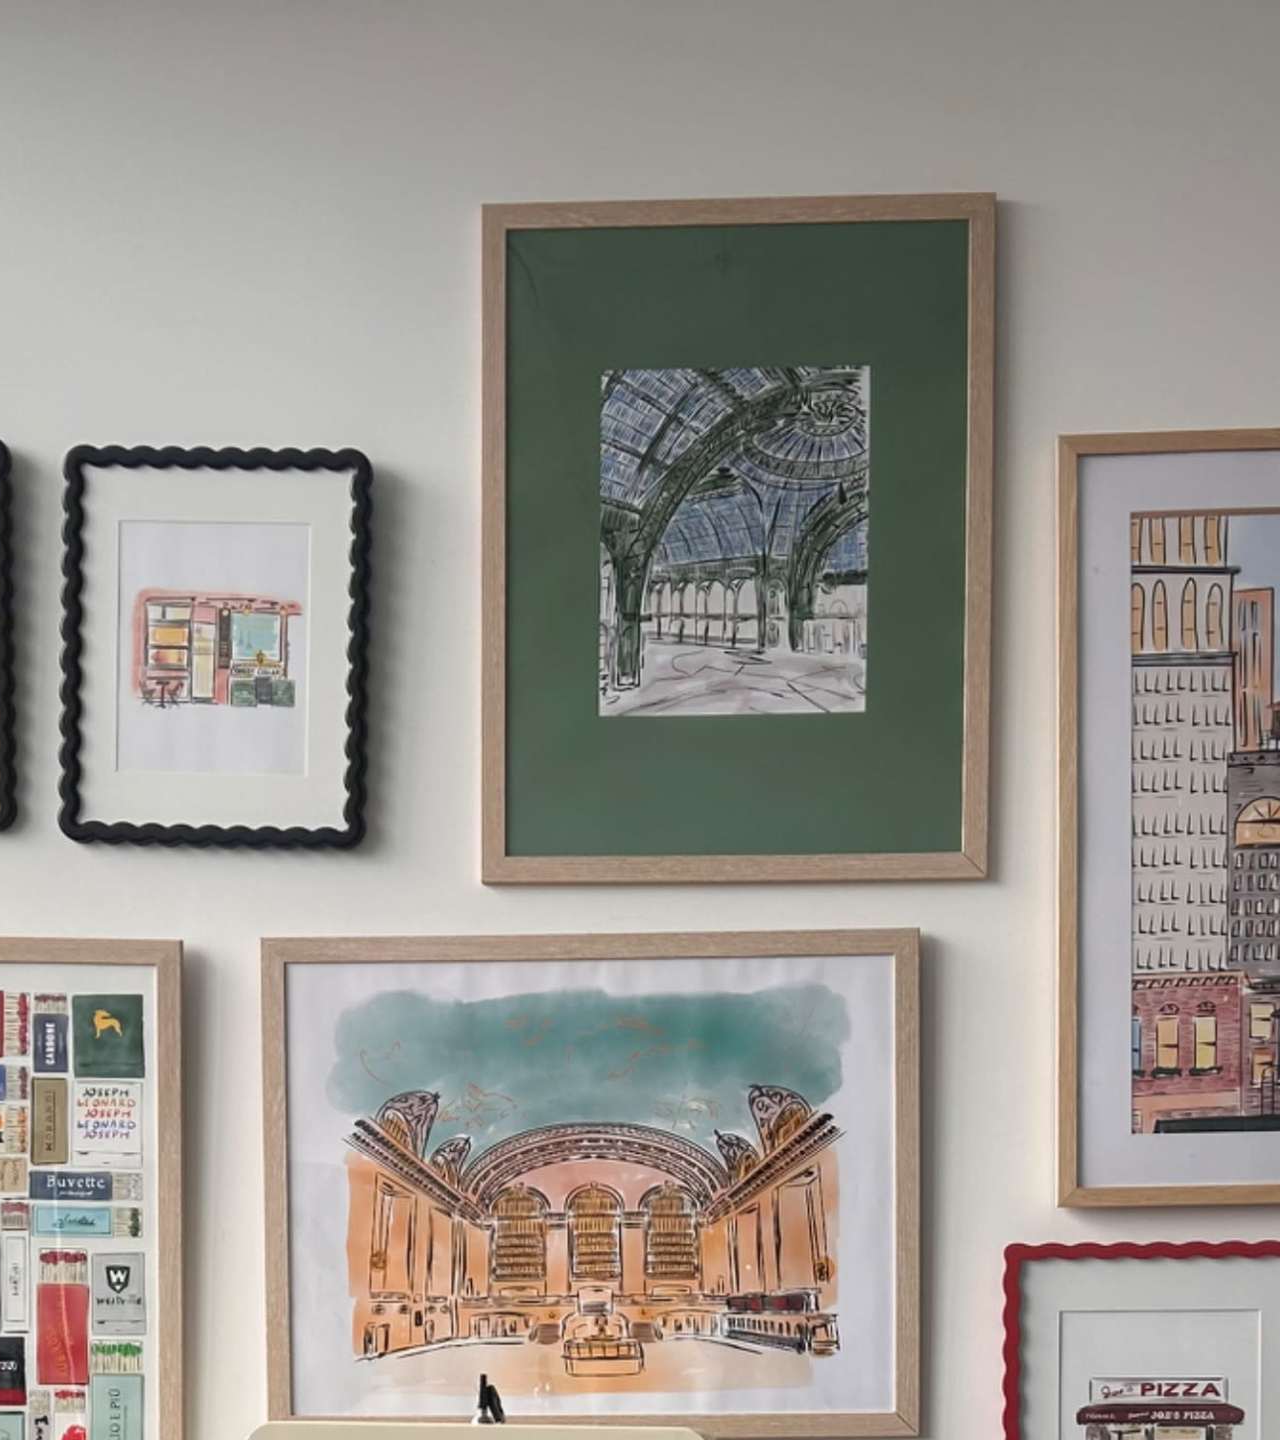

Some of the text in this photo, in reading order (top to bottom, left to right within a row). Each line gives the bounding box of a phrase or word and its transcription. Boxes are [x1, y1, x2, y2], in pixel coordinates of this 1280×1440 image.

[82, 1087, 129, 1098] JOSEPH
[85, 1108, 131, 1118] JOSEPH
[83, 1129, 130, 1139] JOSEPH
[46, 1174, 106, 1189] Buvette
[1139, 1382, 1221, 1398] PIZZA
[1150, 1410, 1181, 1420] JOE'S
[1183, 1410, 1216, 1420] PIZZA
